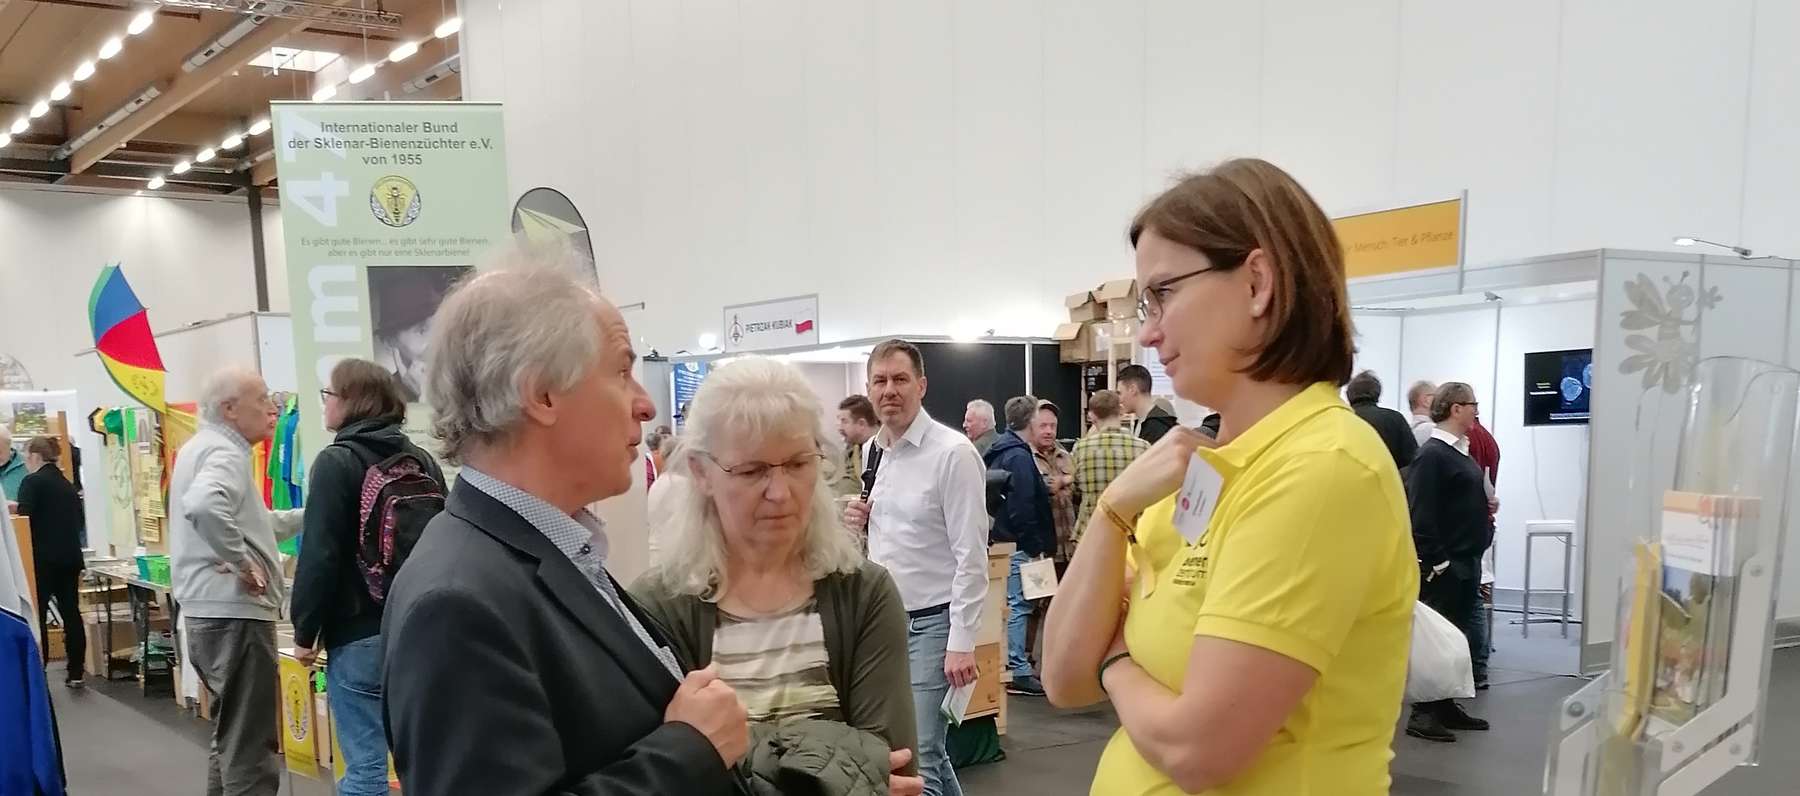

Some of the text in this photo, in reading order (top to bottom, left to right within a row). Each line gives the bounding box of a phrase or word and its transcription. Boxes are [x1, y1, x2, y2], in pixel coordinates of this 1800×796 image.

[320, 121, 458, 133] Internationaler Bund
[288, 137, 493, 149] der Sklenar-Bienenzüchter e.V.
[362, 153, 422, 165] von 1955
[313, 238, 329, 248] gibt
